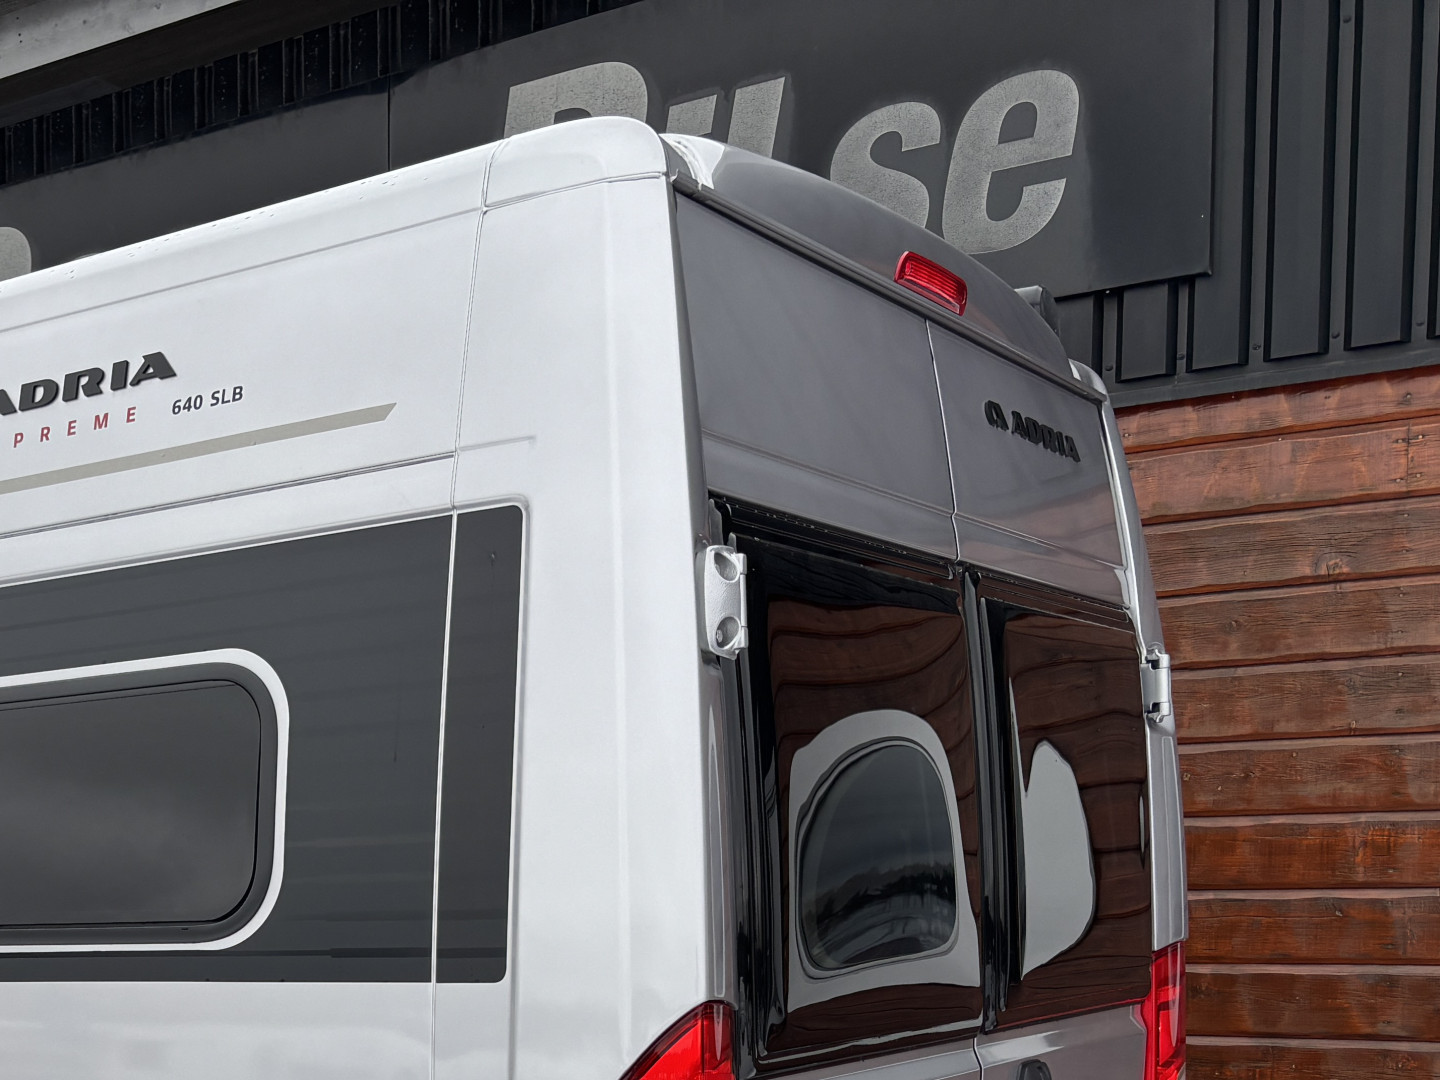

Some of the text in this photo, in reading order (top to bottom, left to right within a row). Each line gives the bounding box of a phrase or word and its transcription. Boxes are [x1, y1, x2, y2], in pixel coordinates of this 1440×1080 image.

[172, 394, 203, 415] 640
[210, 385, 244, 407] SLB
[1011, 410, 1081, 463] ADRIA
